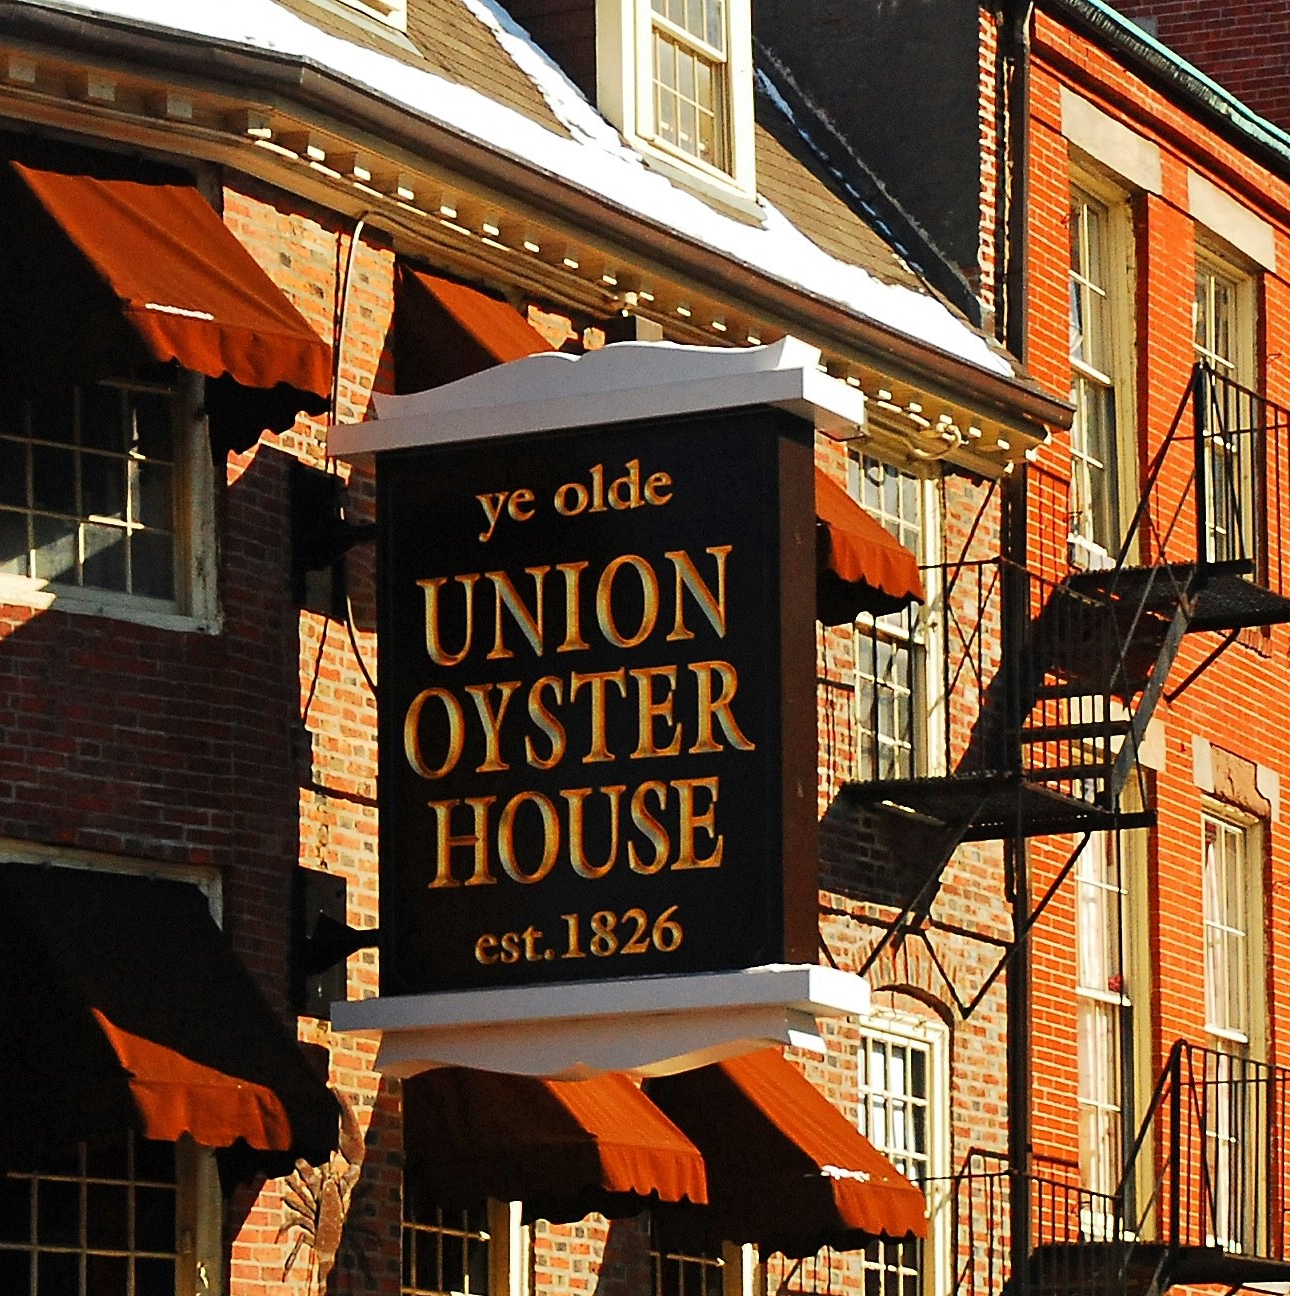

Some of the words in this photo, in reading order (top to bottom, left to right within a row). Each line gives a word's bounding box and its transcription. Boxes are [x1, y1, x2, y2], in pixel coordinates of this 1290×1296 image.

[475, 482, 536, 542] ye
[554, 458, 675, 517] olde
[416, 544, 733, 667] UNION
[403, 659, 756, 780] OYSTER
[426, 775, 724, 890] HOUSE
